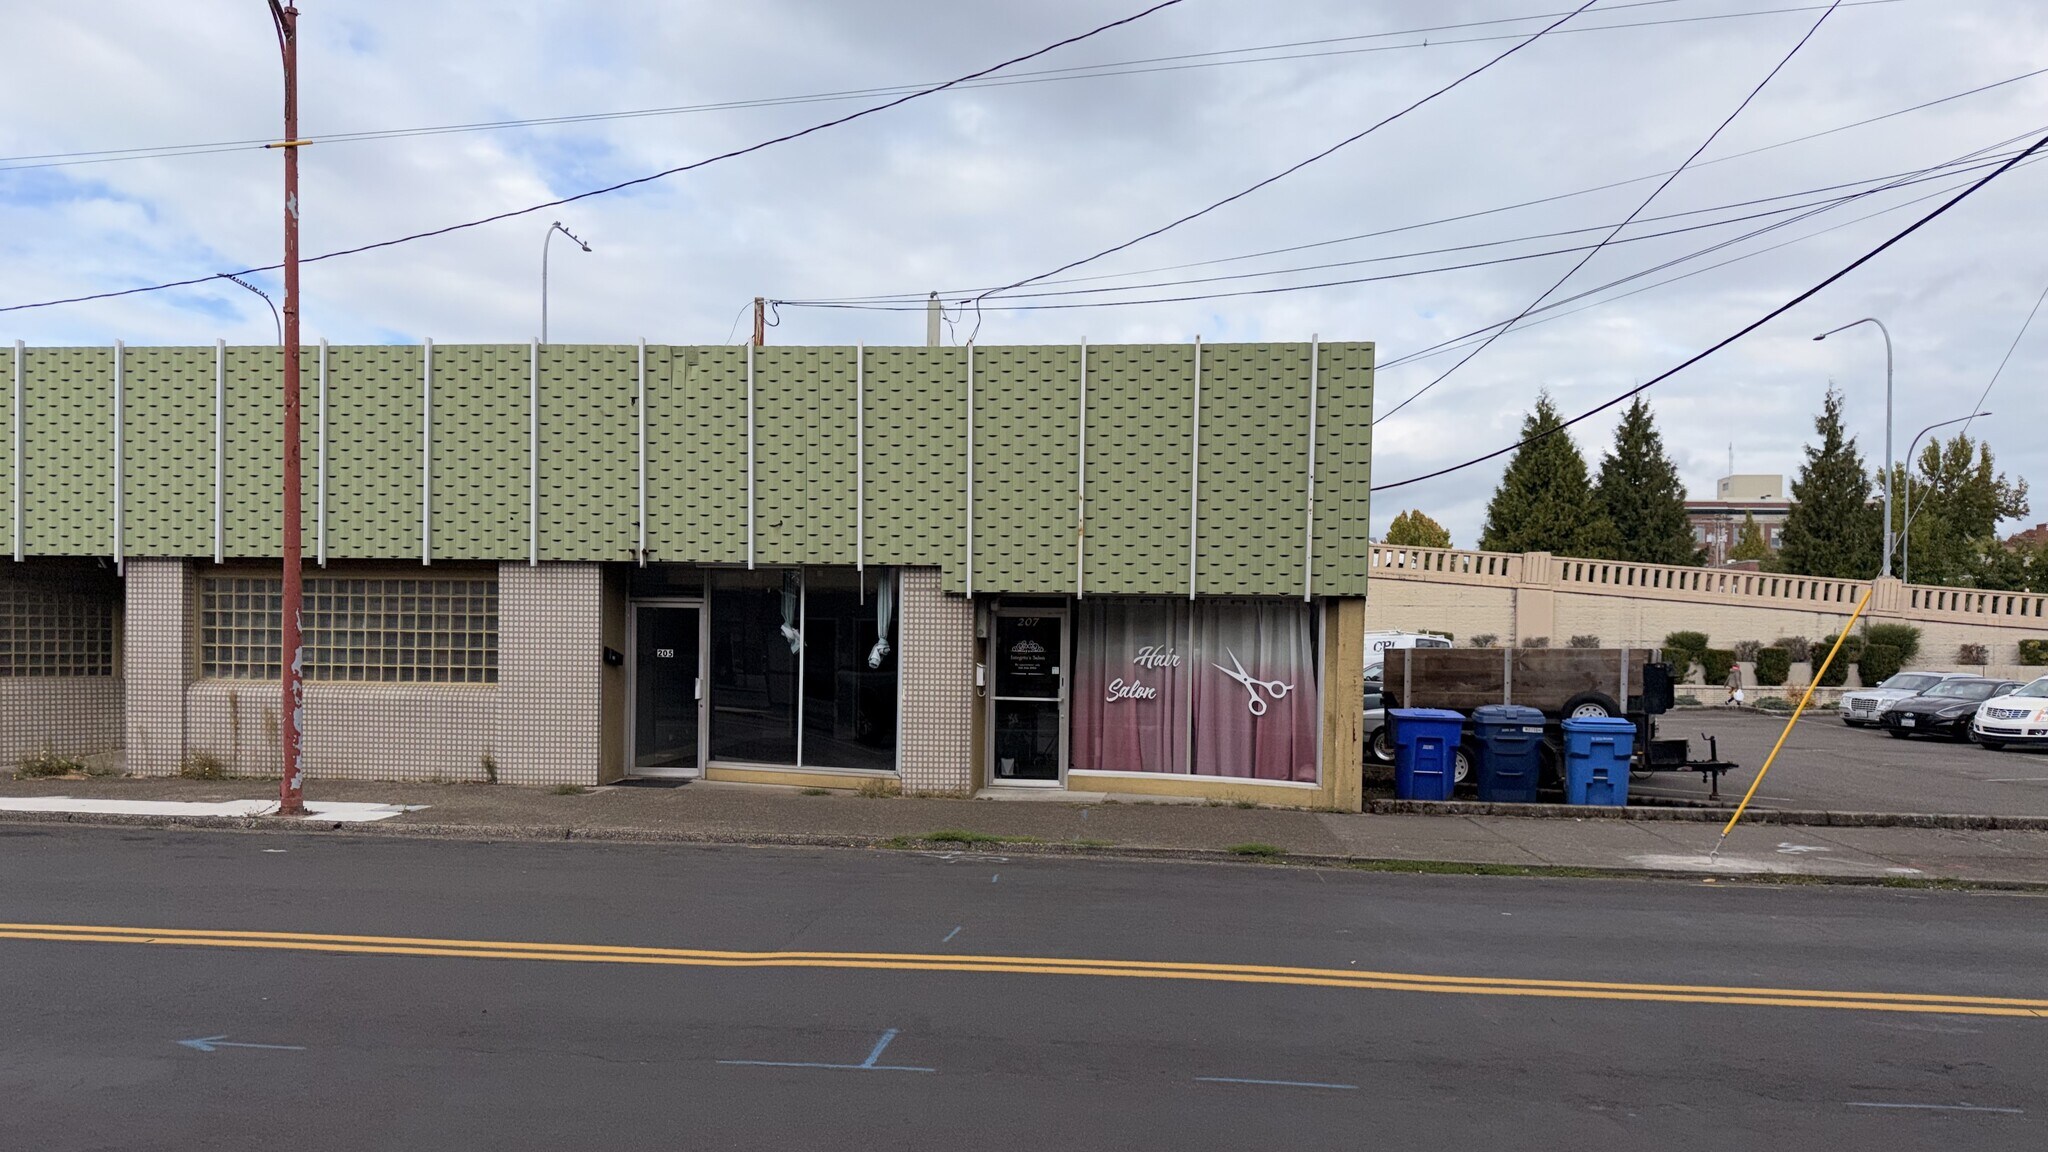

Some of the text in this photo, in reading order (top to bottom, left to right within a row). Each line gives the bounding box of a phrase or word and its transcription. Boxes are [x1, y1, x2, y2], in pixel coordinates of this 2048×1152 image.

[1017, 617, 1040, 627] 207
[657, 649, 674, 658] 205
[1133, 643, 1181, 669] Hair
[1106, 677, 1157, 702] Salon
